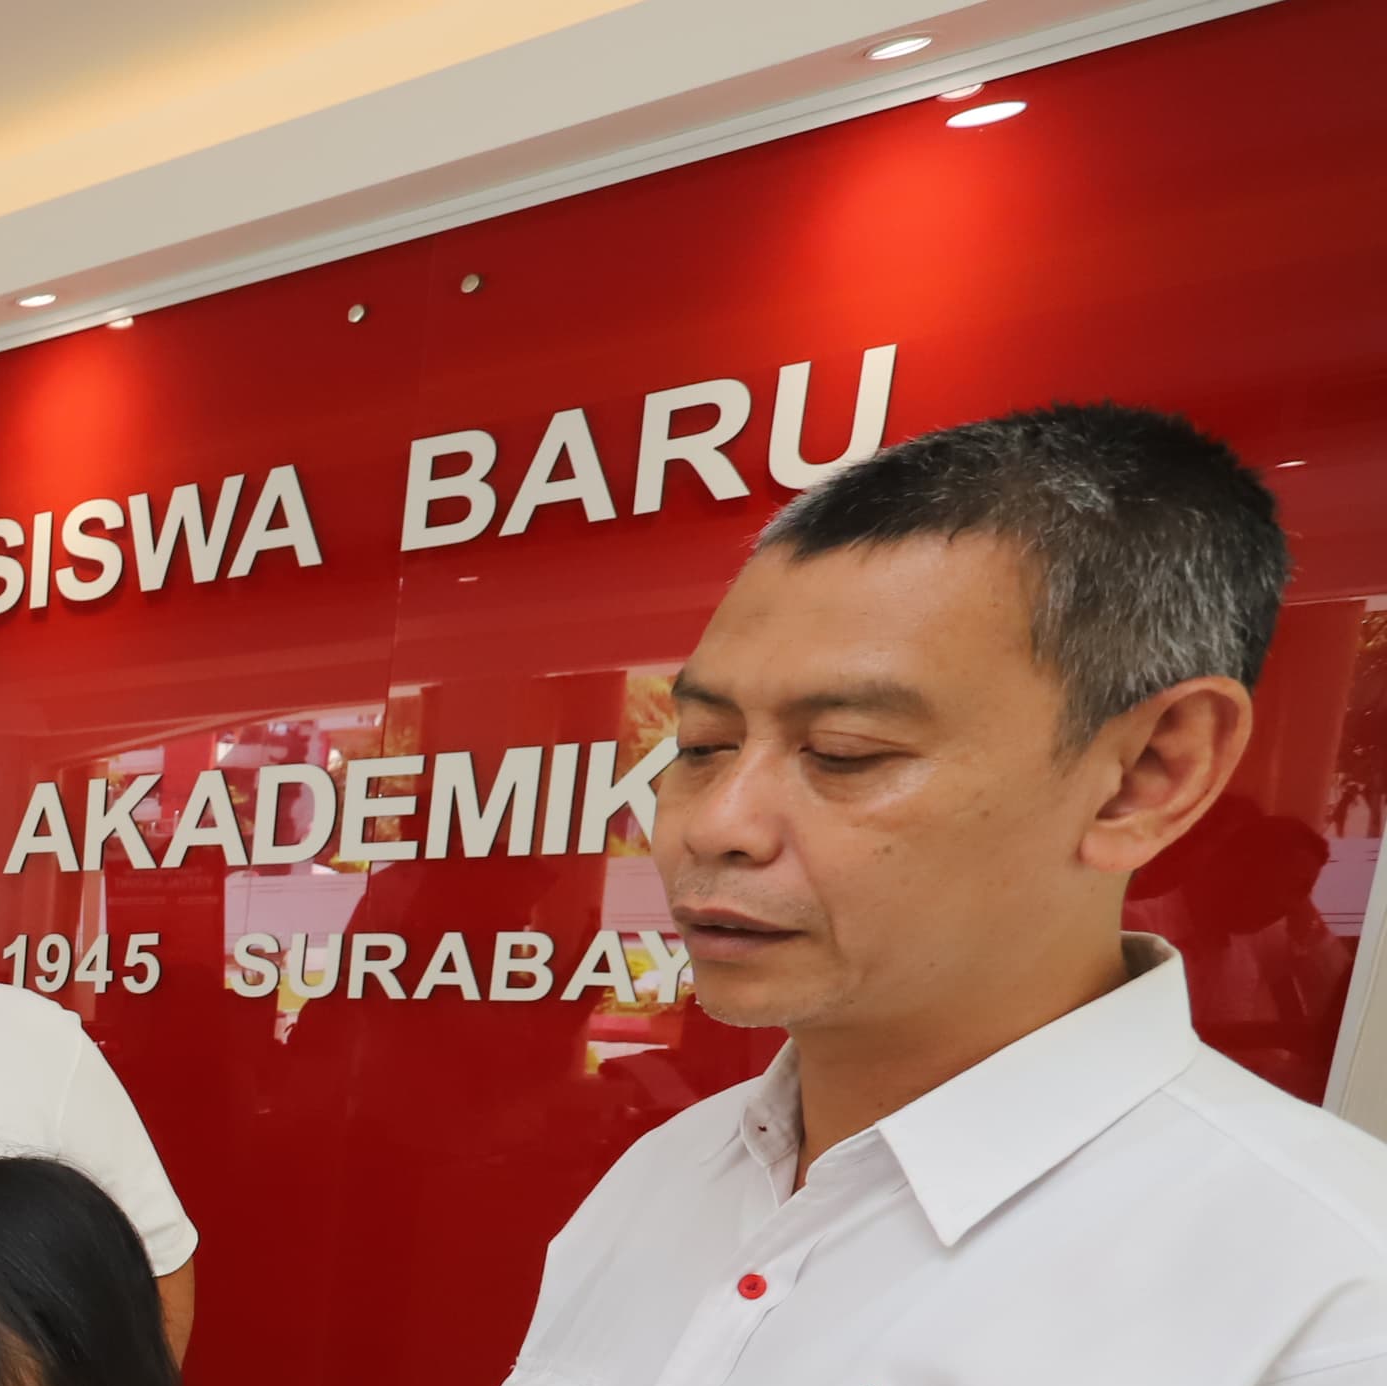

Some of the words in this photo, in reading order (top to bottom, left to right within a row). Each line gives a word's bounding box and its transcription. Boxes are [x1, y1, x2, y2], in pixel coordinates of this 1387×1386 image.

[401, 344, 897, 552] BARU
[4, 736, 678, 874] AKADEMIK
[3, 933, 161, 994] 1945
[230, 930, 690, 1003] SURABAY
